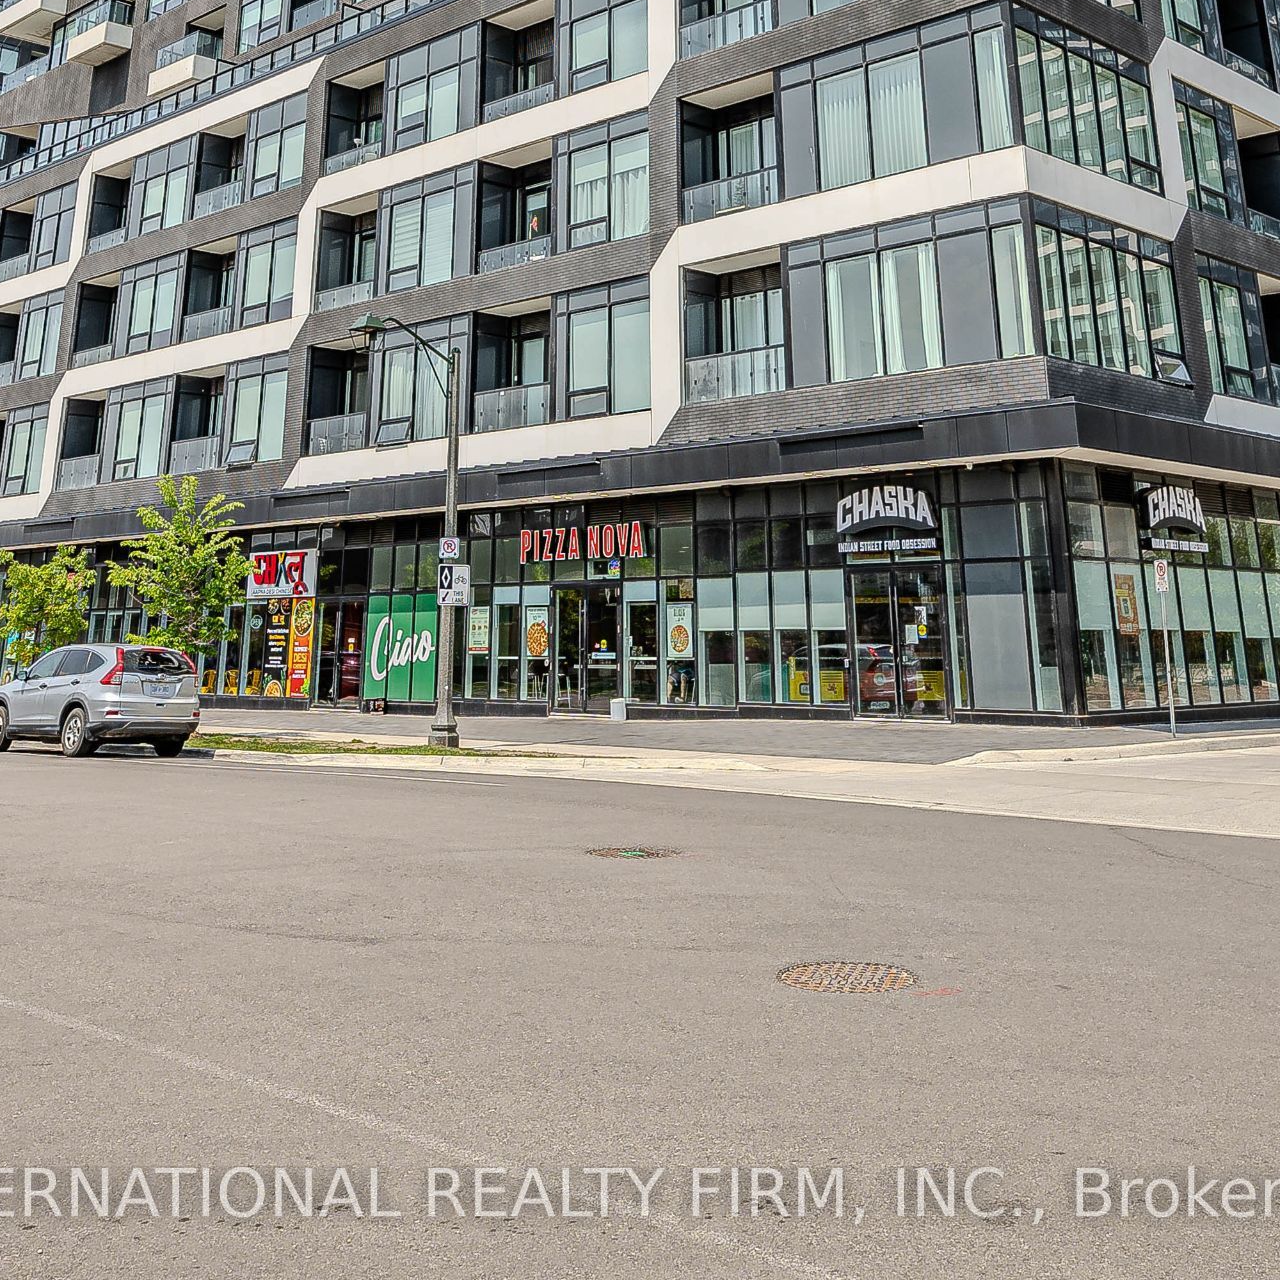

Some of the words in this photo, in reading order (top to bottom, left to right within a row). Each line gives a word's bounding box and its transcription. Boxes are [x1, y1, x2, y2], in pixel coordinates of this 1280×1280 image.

[836, 485, 935, 533] CHASKA
[1147, 486, 1207, 533] CHASKA
[520, 526, 580, 565] PIZZA
[587, 521, 643, 559] NOVA
[838, 541, 858, 553] INDIAN
[859, 540, 882, 552] STREET
[884, 539, 900, 551] FOOD
[901, 537, 937, 550] OBSESSION
[371, 616, 435, 681] Ciao
